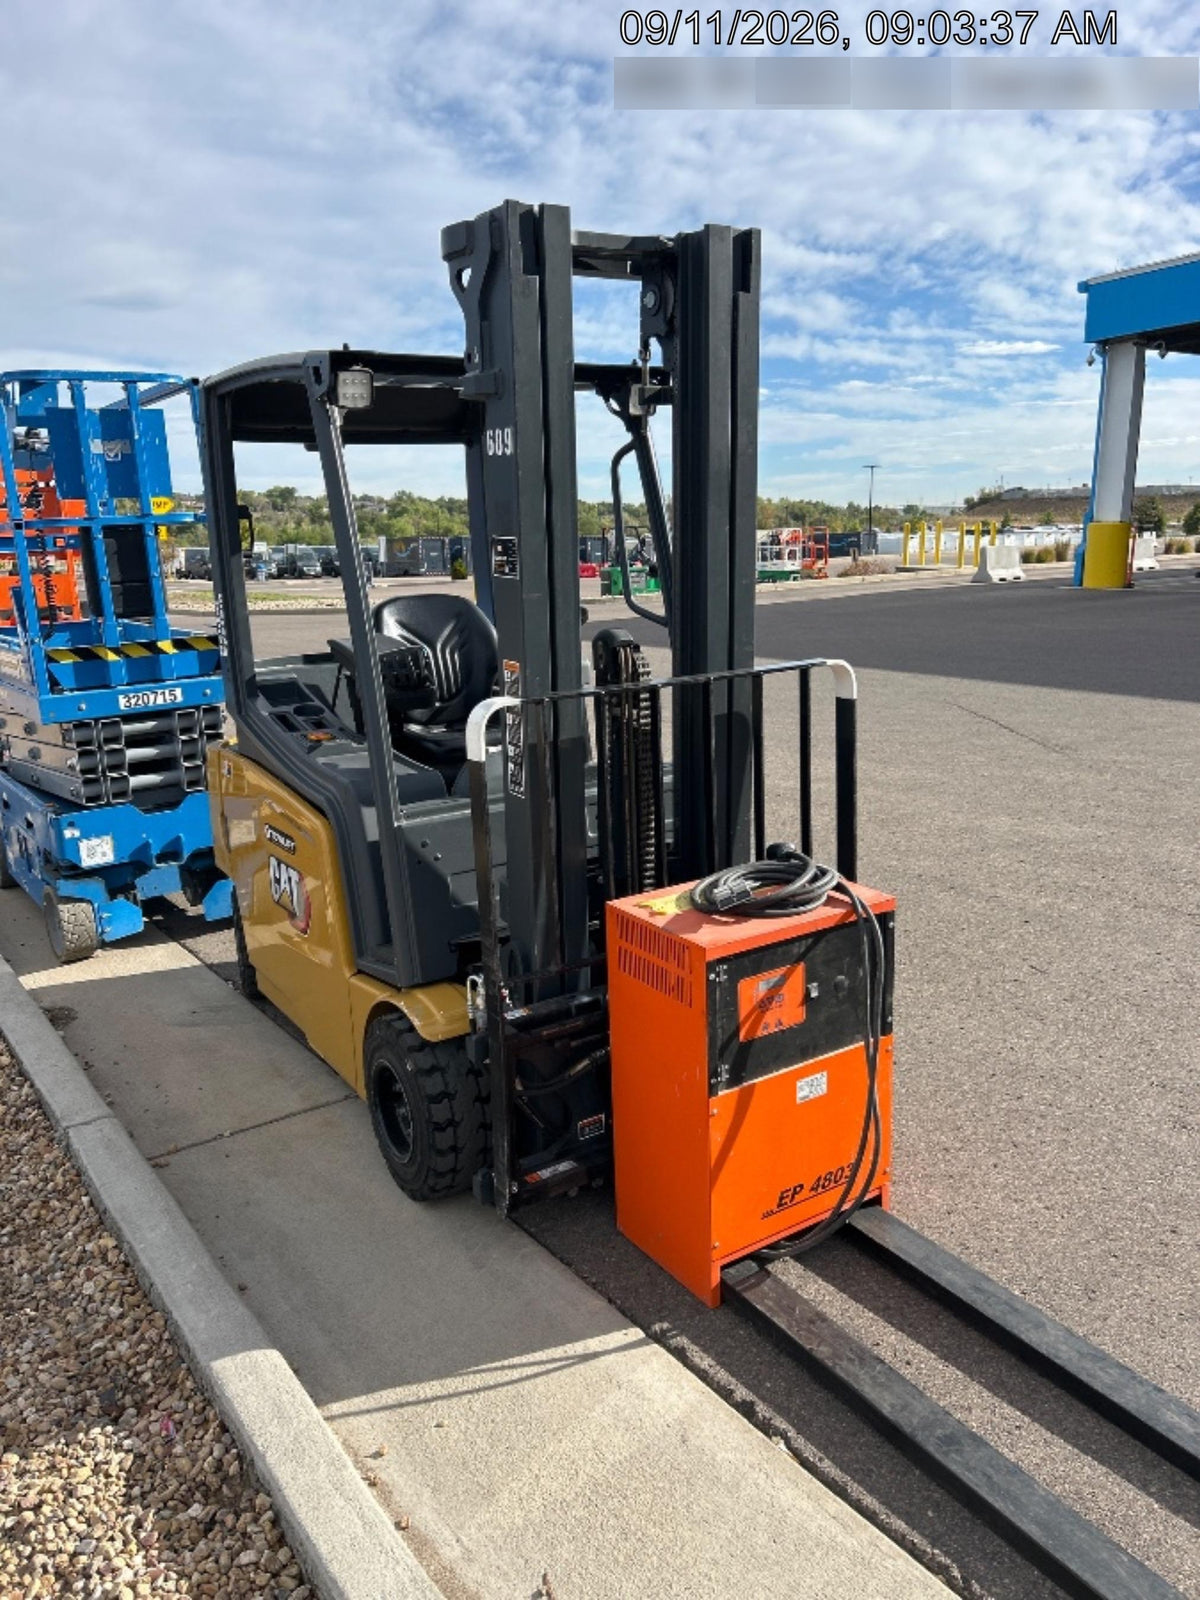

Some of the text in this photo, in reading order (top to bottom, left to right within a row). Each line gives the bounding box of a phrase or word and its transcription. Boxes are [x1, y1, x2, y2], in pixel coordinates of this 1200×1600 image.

[122, 689, 177, 708] 320715
[268, 855, 301, 916] CAT
[777, 1183, 805, 1208] EP
